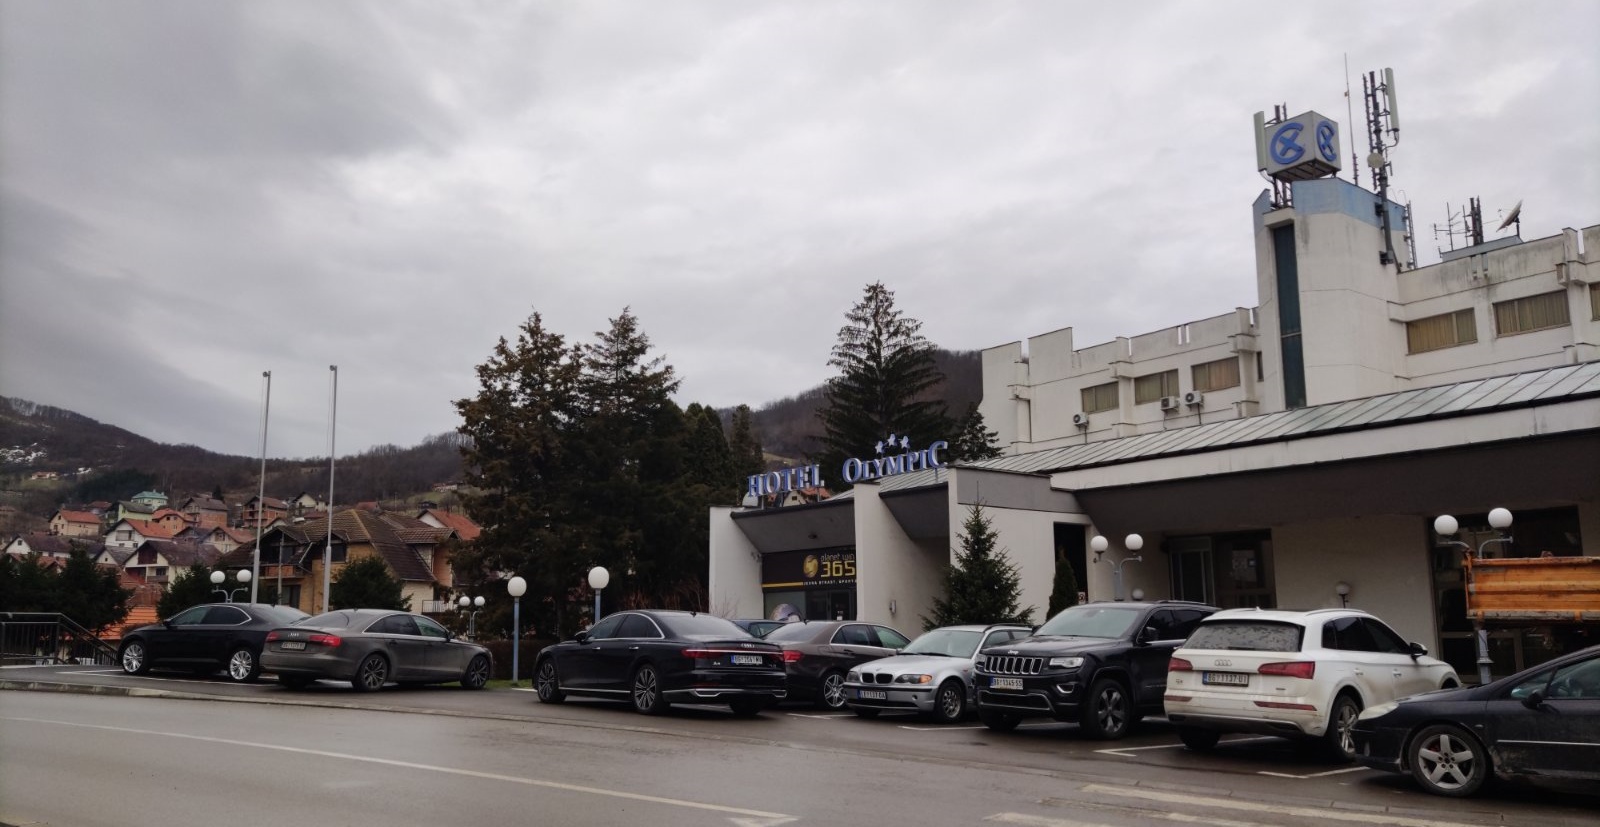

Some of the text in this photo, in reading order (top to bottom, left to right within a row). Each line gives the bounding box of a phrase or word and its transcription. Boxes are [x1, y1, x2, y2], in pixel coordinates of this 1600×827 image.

[747, 440, 948, 498] HOTEL OLYMPIC
[821, 561, 856, 577] 365
